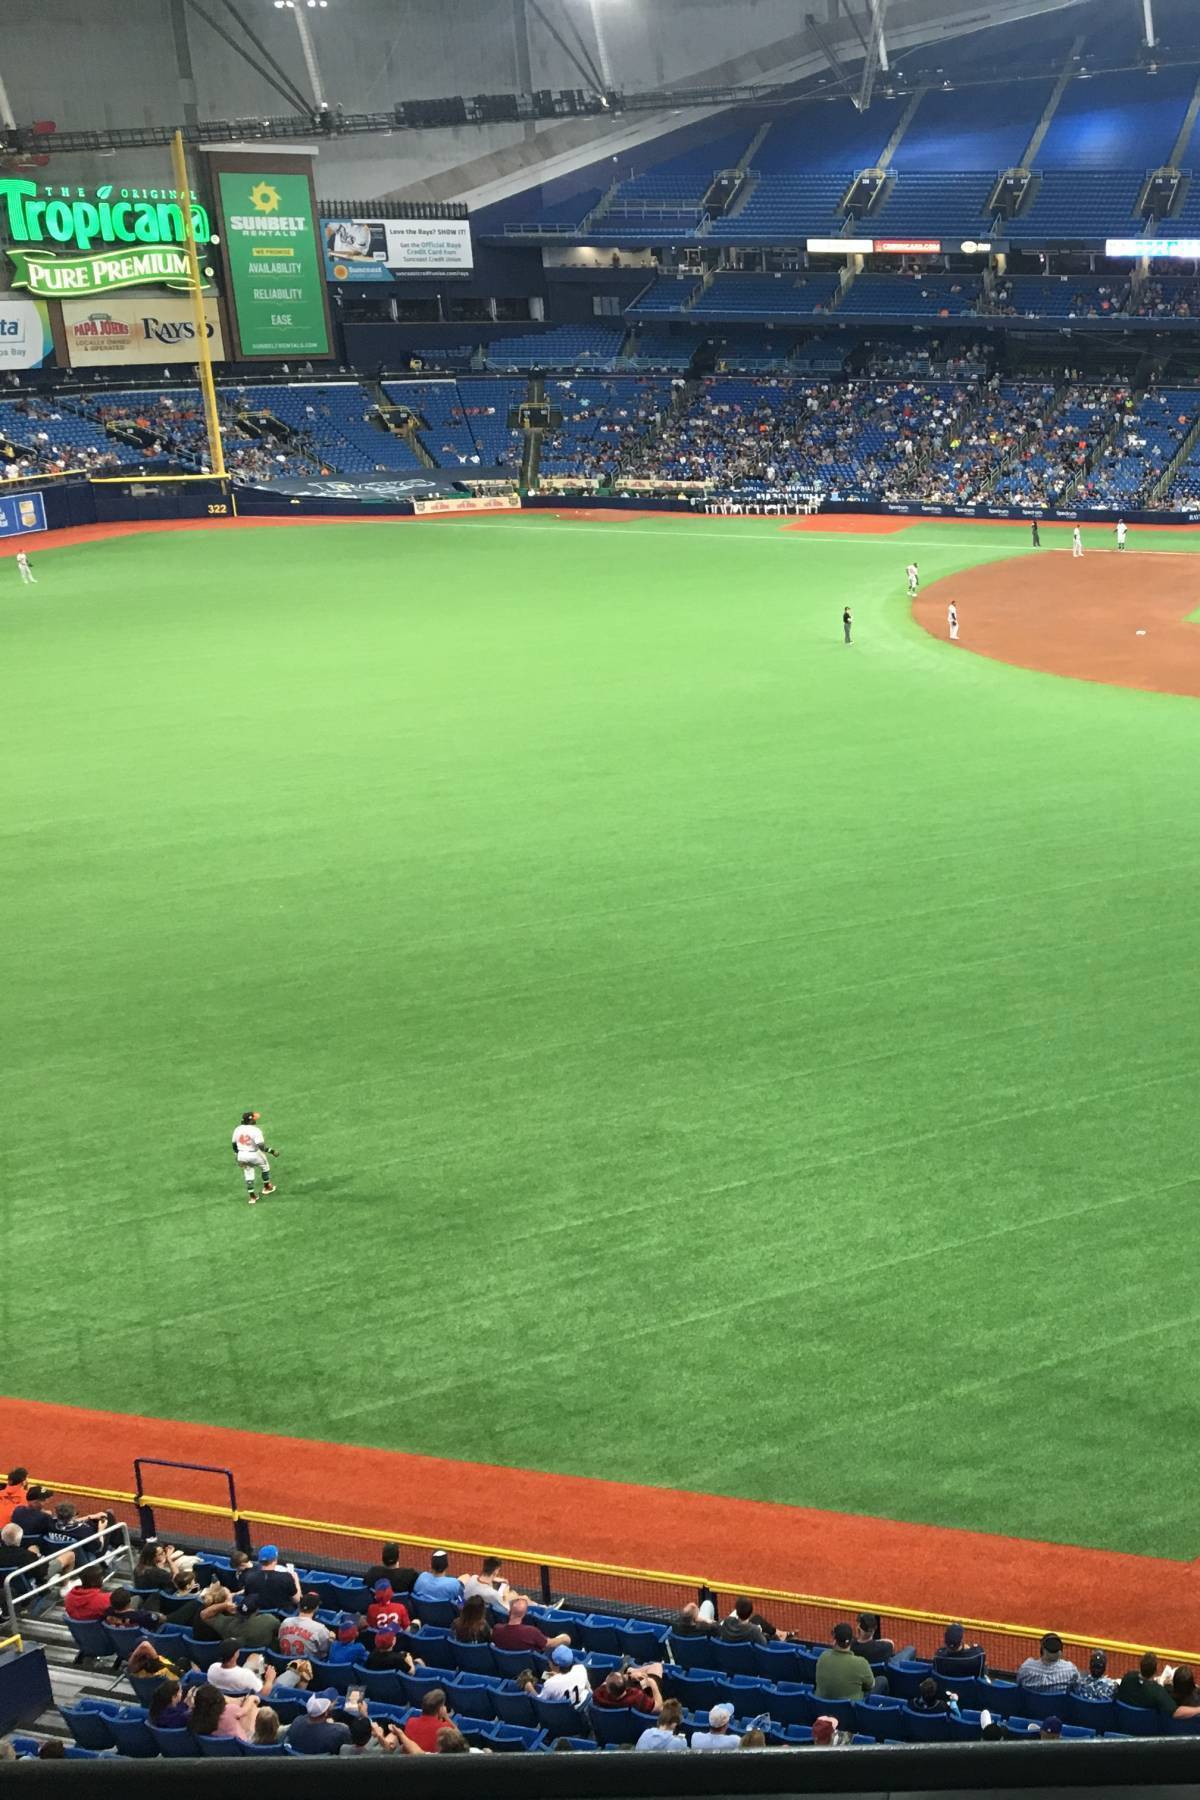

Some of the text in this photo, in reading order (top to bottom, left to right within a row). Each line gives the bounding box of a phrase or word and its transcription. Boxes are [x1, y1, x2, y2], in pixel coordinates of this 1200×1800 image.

[45, 186, 197, 200] THE ORIGINAL
[0, 179, 211, 250] Tropicana
[230, 216, 306, 231] SUNBELT
[28, 253, 192, 290] PURE PREMIUM
[248, 262, 302, 273] AVAILABILITY
[253, 288, 303, 300] RELIABILITY
[271, 314, 293, 326] EASE
[74, 320, 99, 337] PAPA
[207, 504, 228, 514] 322
